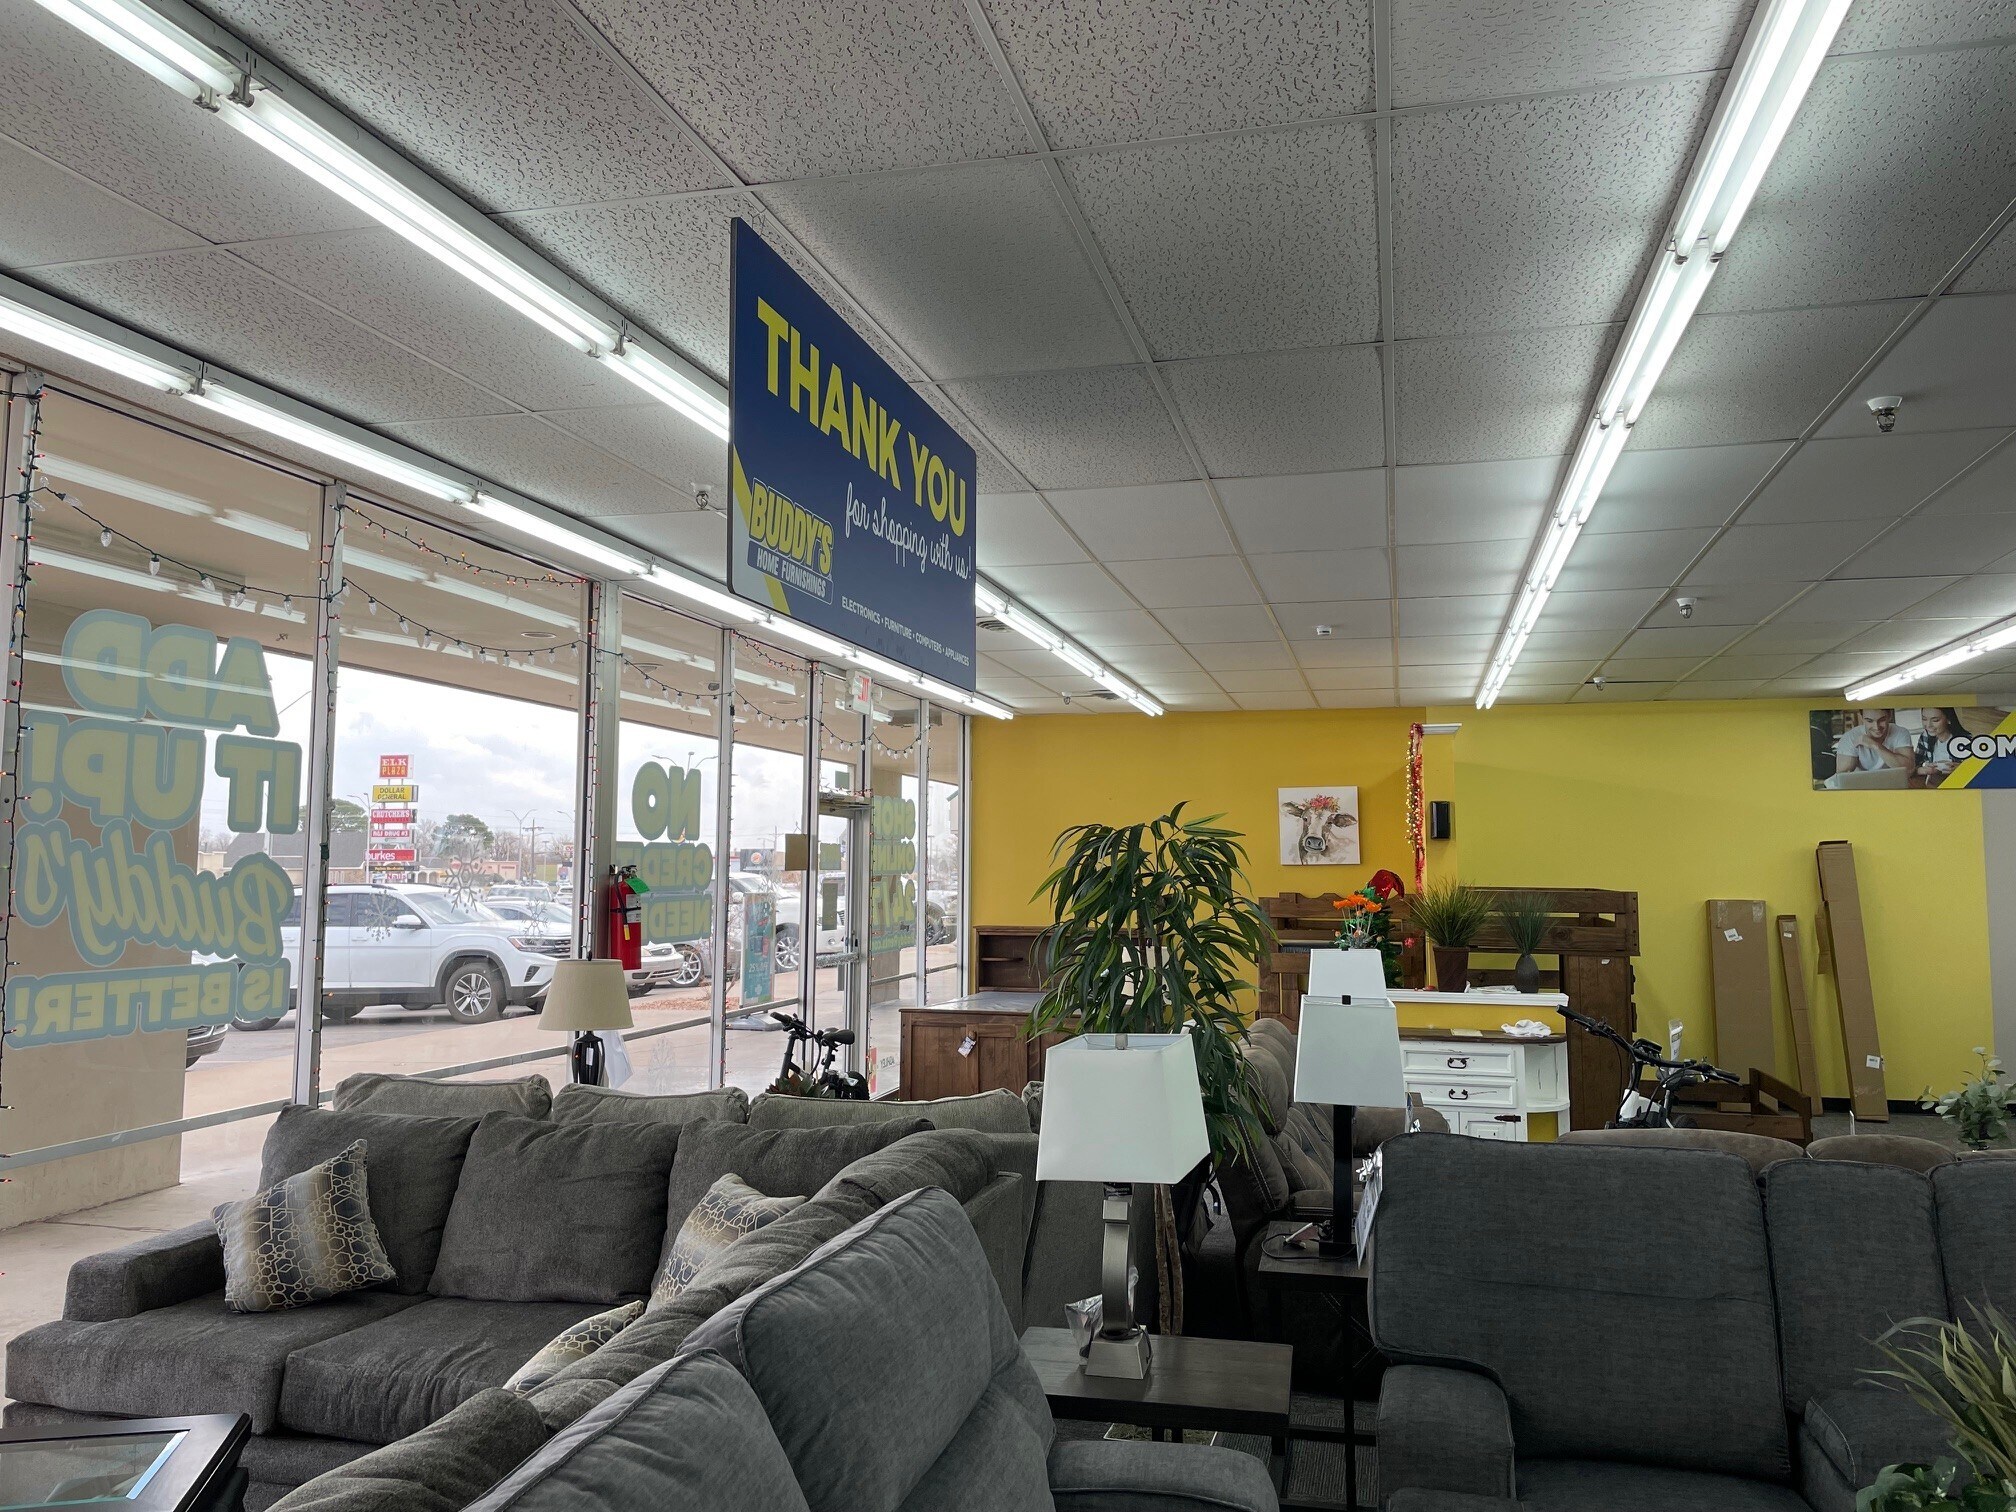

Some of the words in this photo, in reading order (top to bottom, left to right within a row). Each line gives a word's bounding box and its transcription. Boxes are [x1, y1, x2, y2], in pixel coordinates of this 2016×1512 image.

[758, 296, 901, 491] THANK
[908, 432, 966, 537] YOU
[750, 482, 833, 575] BUDDY'S
[845, 481, 870, 539] for
[872, 496, 928, 574] shopping
[930, 532, 953, 572] with
[955, 545, 972, 580] us!
[756, 547, 780, 576] HOME
[781, 559, 827, 598] FURNISHINGS
[842, 596, 880, 625] ELECTRONICS
[884, 616, 912, 639] FURNITURE
[915, 632, 942, 654] COMPUTERS
[945, 647, 970, 667] APPLIANCES
[382, 758, 406, 766] ELK
[382, 766, 405, 776] PLAZA
